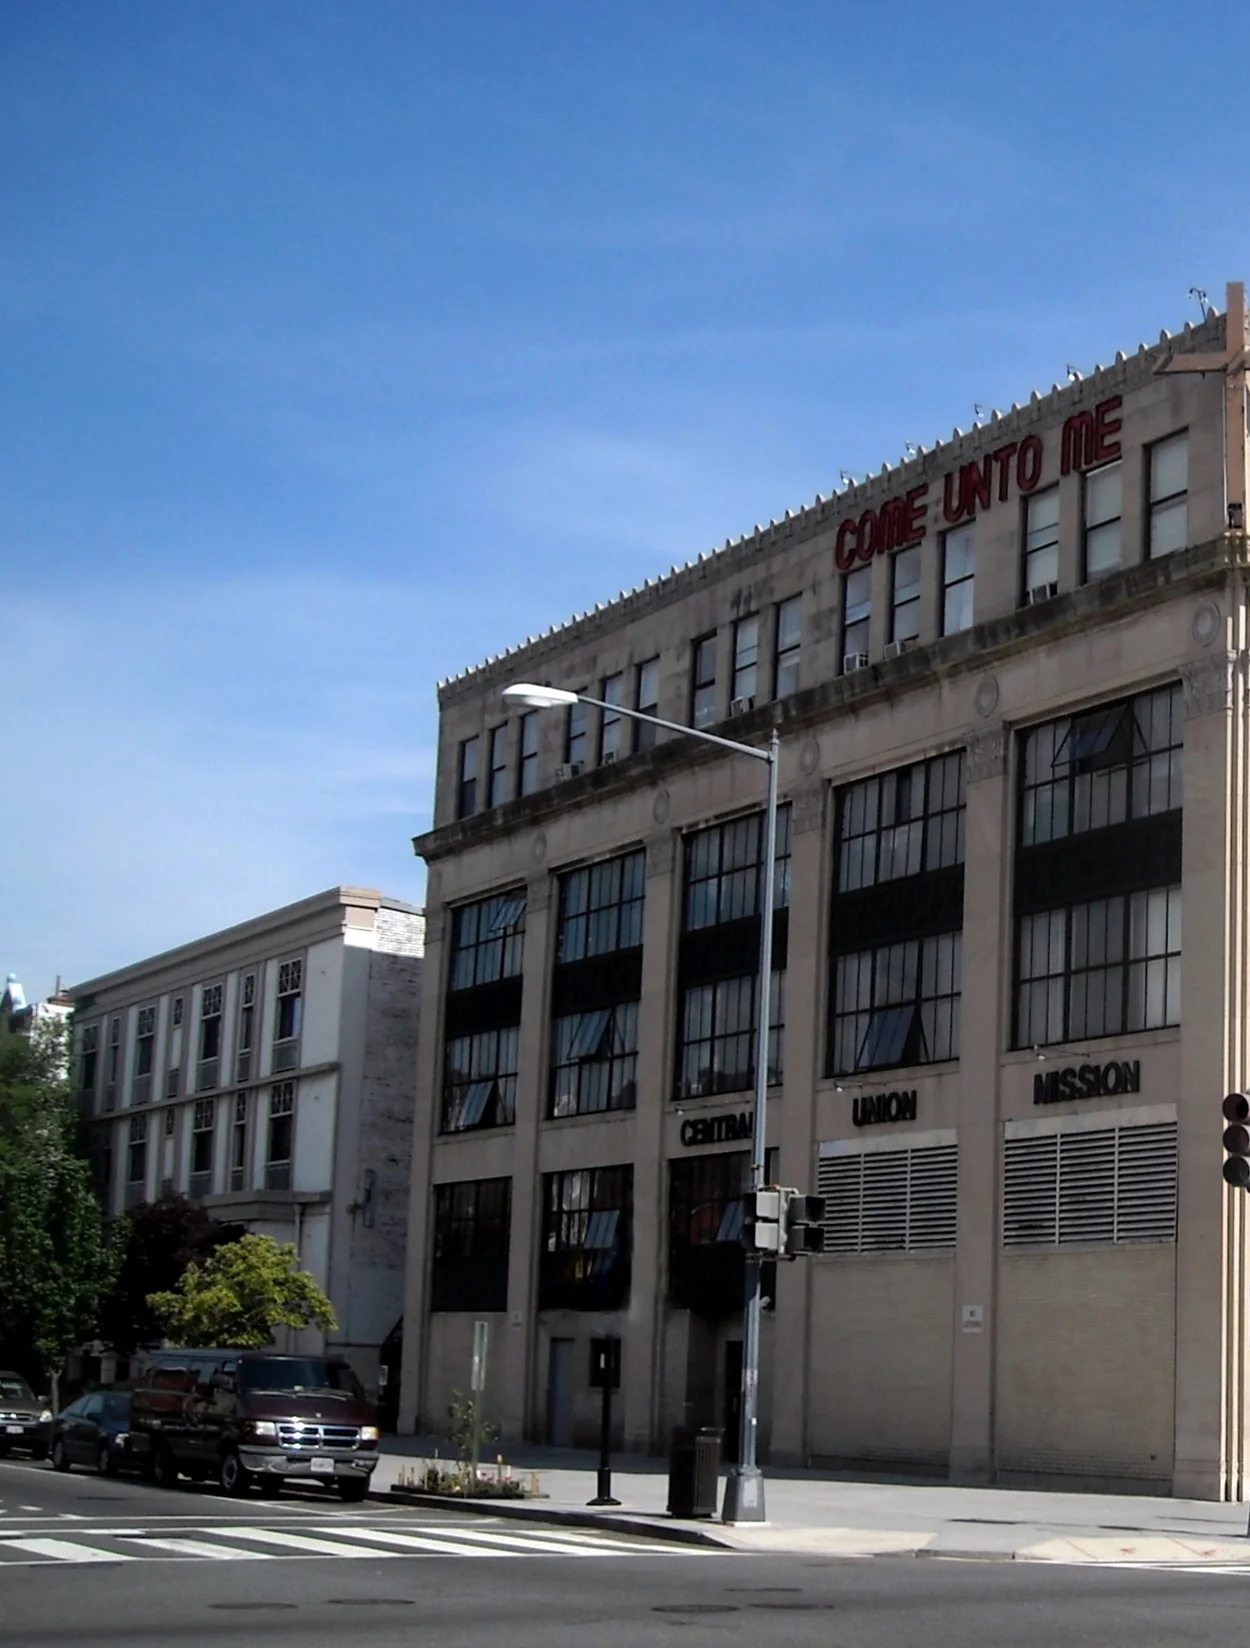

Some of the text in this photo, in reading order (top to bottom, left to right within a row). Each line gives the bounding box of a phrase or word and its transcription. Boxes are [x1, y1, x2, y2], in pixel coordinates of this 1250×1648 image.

[835, 396, 1123, 570] COME UNTO ME
[852, 1090, 917, 1127] UNION
[1033, 1061, 1140, 1105] MISSION
